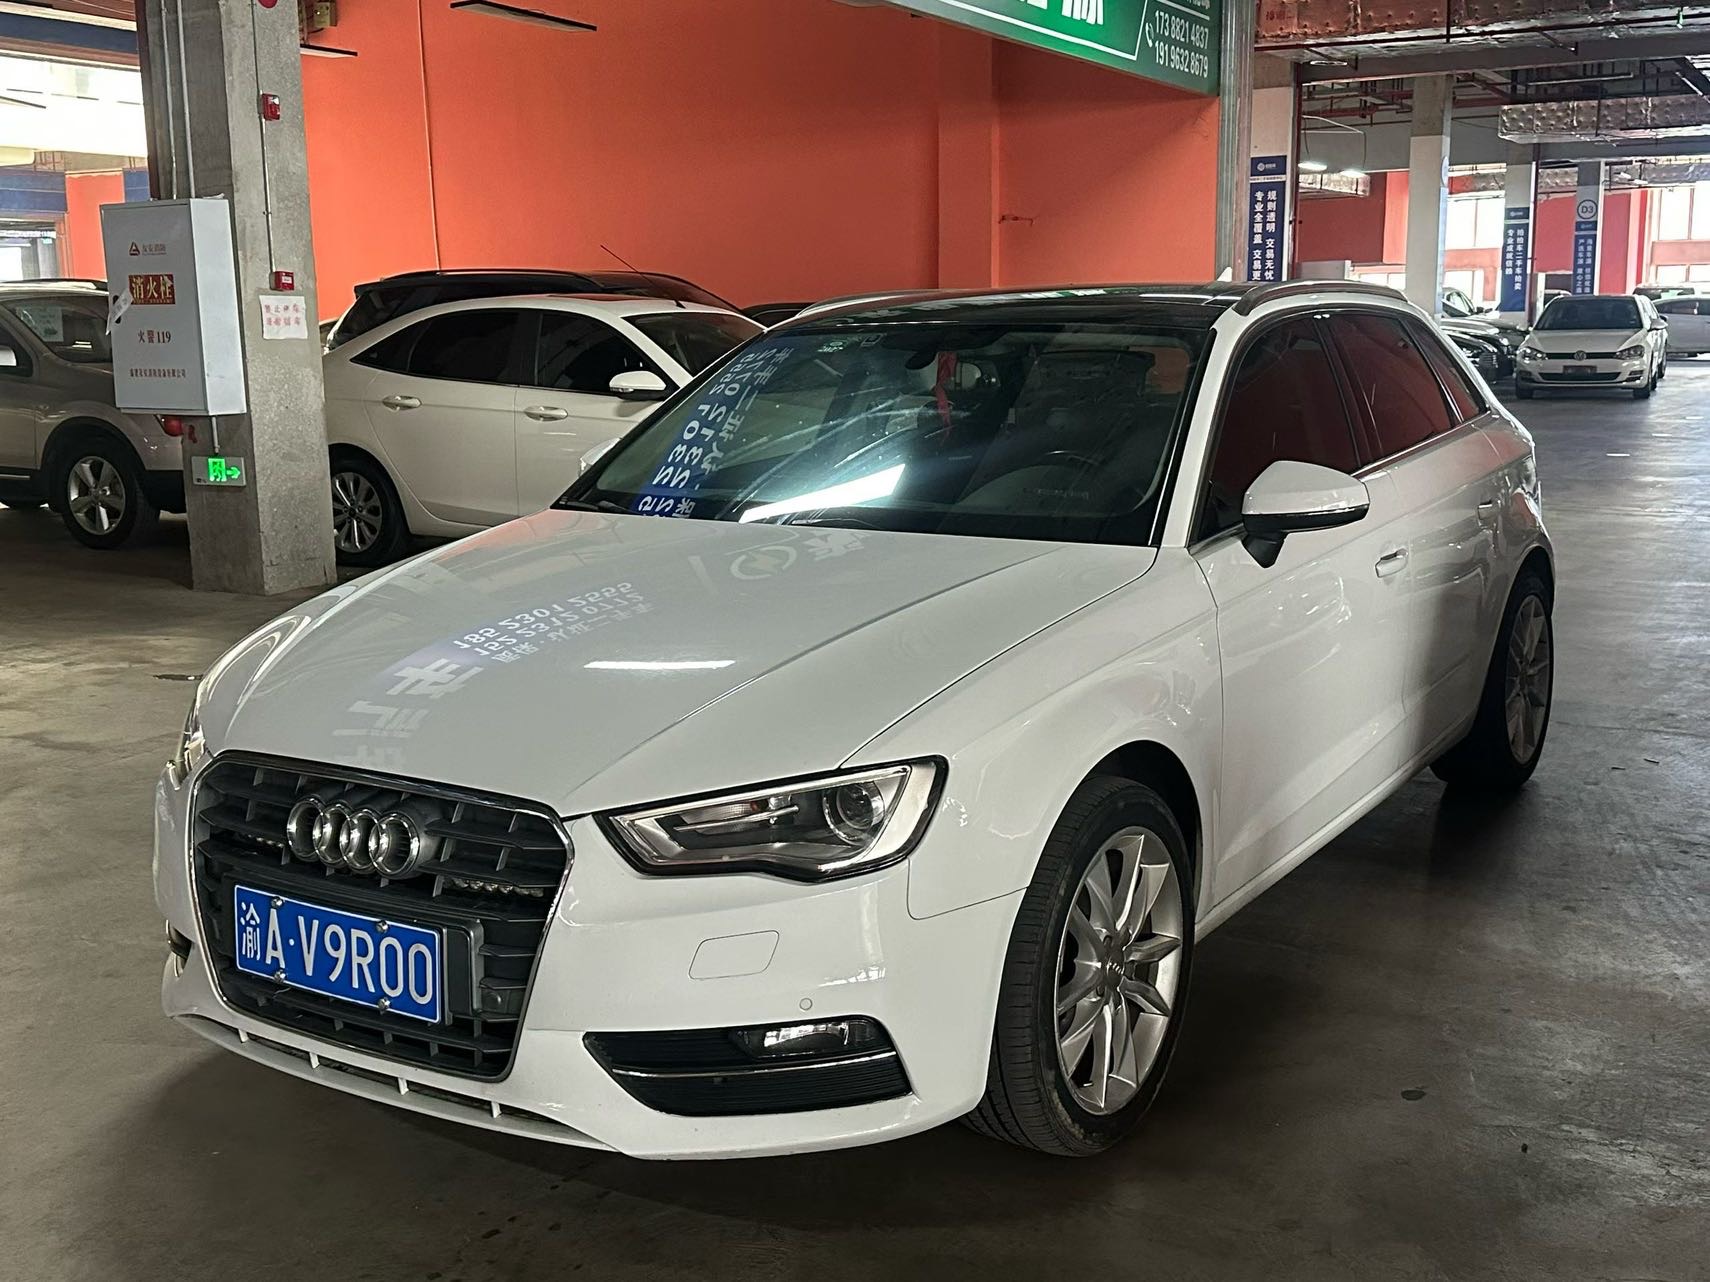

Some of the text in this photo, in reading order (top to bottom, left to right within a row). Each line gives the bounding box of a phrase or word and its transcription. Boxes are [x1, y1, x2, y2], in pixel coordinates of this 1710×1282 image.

[1155, 10, 1209, 50] 173 8821 4837
[1155, 40, 1209, 78] 191 9632 8679
[1253, 190, 1264, 244] 专业全覆盖
[1581, 205, 1594, 214] D3
[1264, 190, 1277, 280] 规则透明 交易无忧
[132, 276, 174, 299] 消火栓
[156, 330, 172, 344] 119
